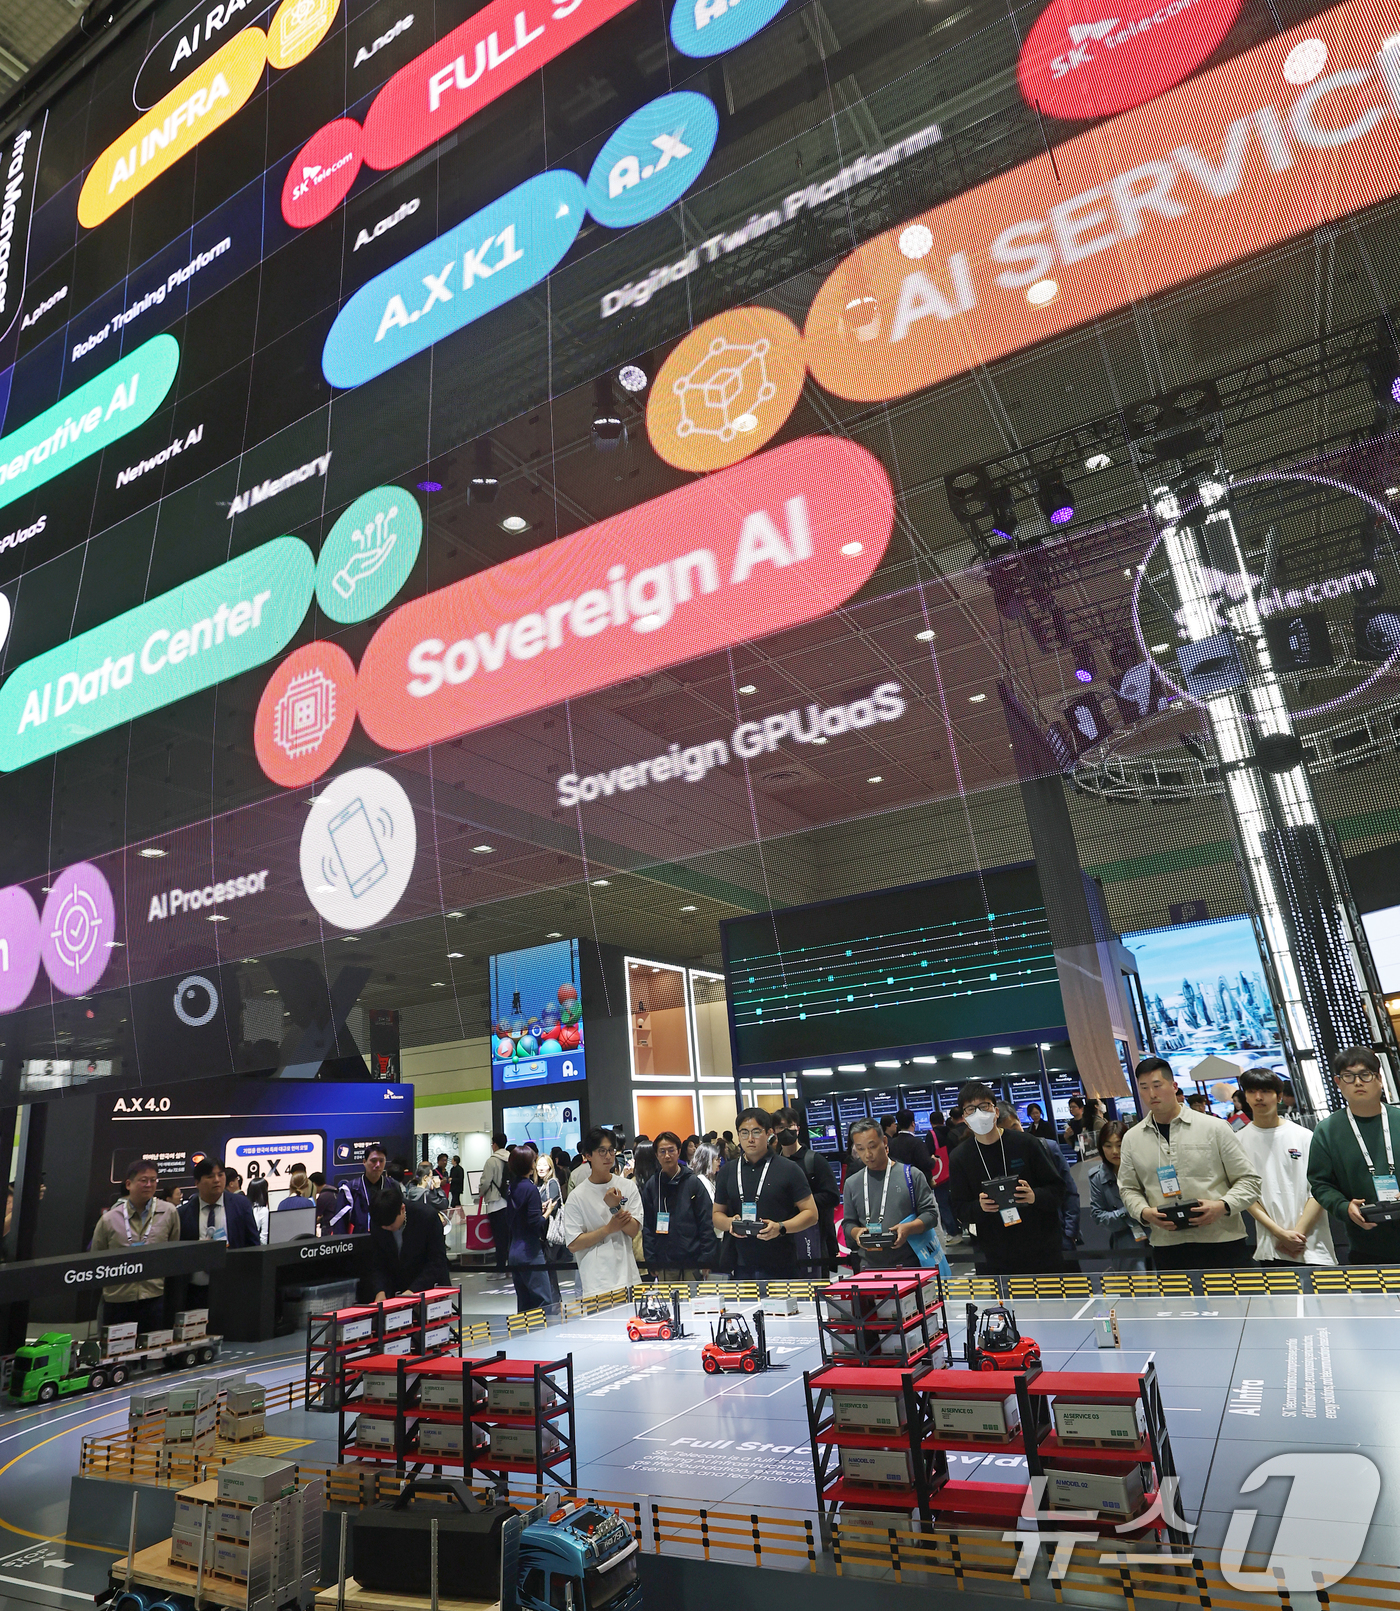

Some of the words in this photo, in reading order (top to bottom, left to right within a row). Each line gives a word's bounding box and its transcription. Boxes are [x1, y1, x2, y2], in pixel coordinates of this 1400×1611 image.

[170, 23, 201, 72] AI
[204, 0, 253, 41] RA
[352, 14, 415, 68] A.note
[429, 11, 546, 112] FULL
[1050, 49, 1093, 79] SK
[108, 150, 137, 194] AI
[140, 72, 230, 166] INFRA
[292, 179, 311, 201] SK
[312, 151, 353, 187] telecom
[608, 124, 693, 199] A.X
[352, 197, 421, 252] A.auto
[601, 249, 699, 319] Digital
[700, 209, 781, 263] Twin
[784, 124, 943, 219] Platform
[72, 330, 110, 363] Robot
[111, 285, 166, 333] Training
[167, 236, 232, 293] Platform
[374, 261, 458, 343] A.X
[463, 223, 525, 291] K1
[890, 252, 977, 343] AI
[20, 285, 69, 332] A.phone
[102, 373, 140, 422] AI
[116, 436, 183, 489] Network
[182, 424, 204, 452] AI
[227, 493, 251, 520] AI
[249, 452, 332, 507] Memory
[0, 514, 48, 554] PUaaS
[406, 548, 719, 698] Sovereign
[731, 494, 814, 584] AI
[17, 690, 51, 735] AI
[54, 653, 134, 718] Data
[140, 590, 271, 676] Center
[557, 733, 729, 807] Sovereign
[731, 680, 909, 761] GPUaaS
[147, 893, 168, 922] AI
[170, 869, 270, 915] Processor
[113, 1097, 143, 1113] A.X
[145, 1097, 171, 1112] 4.0
[63, 1265, 93, 1285] Gas
[95, 1260, 143, 1280] Station
[300, 1244, 325, 1259] Car
[325, 1240, 354, 1256] Service
[1228, 1404, 1261, 1416] AI
[1230, 1379, 1264, 1403] Infra
[643, 1455, 695, 1464] offering
[710, 1459, 806, 1471] infrastructure
[669, 1436, 735, 1450] Full
[673, 1450, 727, 1460] Telecom
[640, 1466, 697, 1475] services
[674, 1462, 751, 1474] foundation,
[753, 1469, 815, 1478] extendin
[1062, 1479, 1080, 1487] MODEL
[1, 1548, 49, 1568] STOP
[14, 1551, 57, 1568] Here
